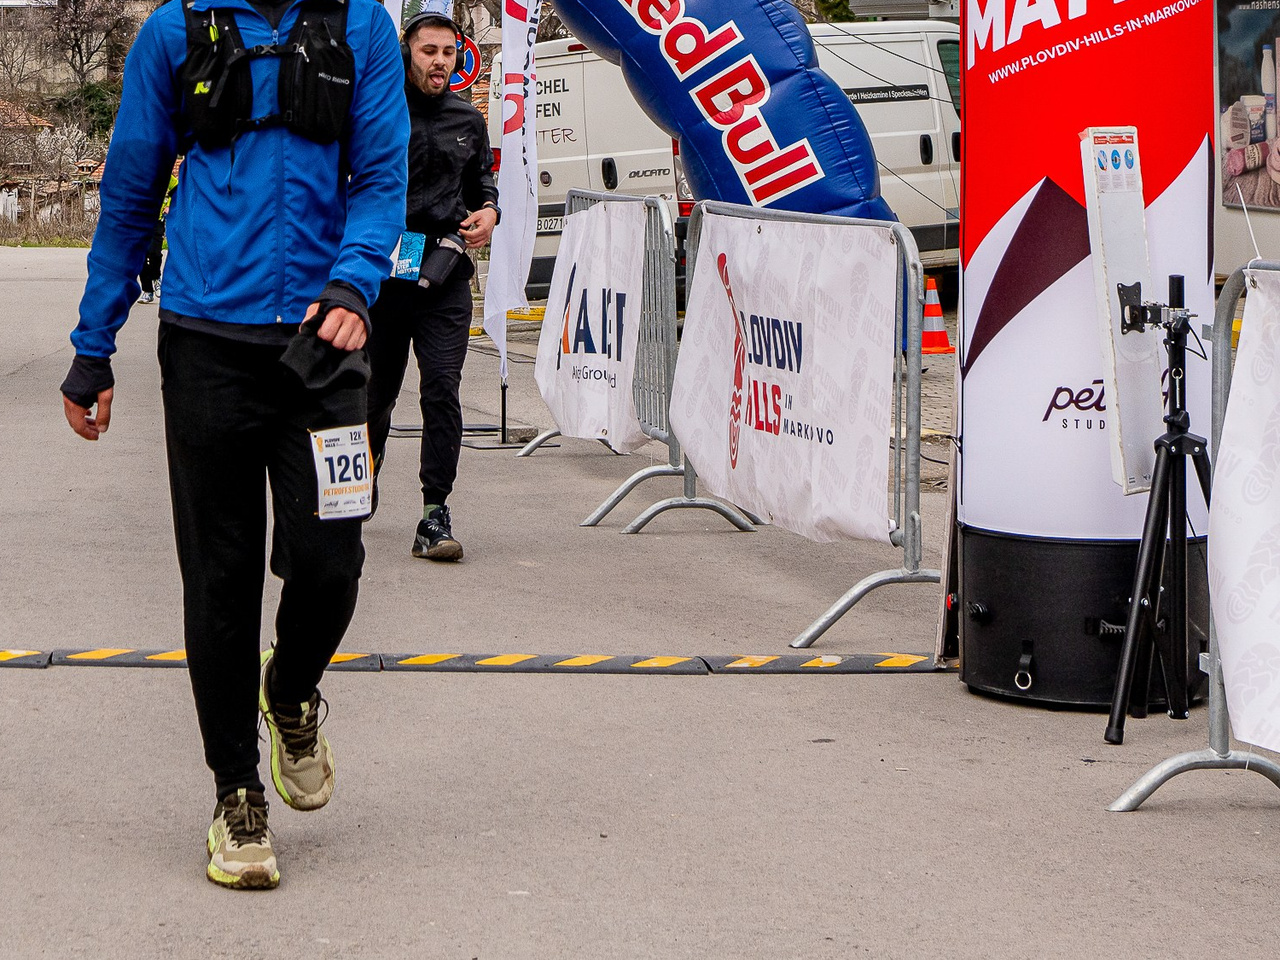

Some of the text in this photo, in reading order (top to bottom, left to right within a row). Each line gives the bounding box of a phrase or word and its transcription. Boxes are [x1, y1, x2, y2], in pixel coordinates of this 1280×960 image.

[536, 79, 570, 95] CHEL
[693, 55, 822, 205] Bull
[629, 168, 670, 179] DUCATO
[784, 393, 793, 411] IN
[1062, 419, 1106, 430] STUD
